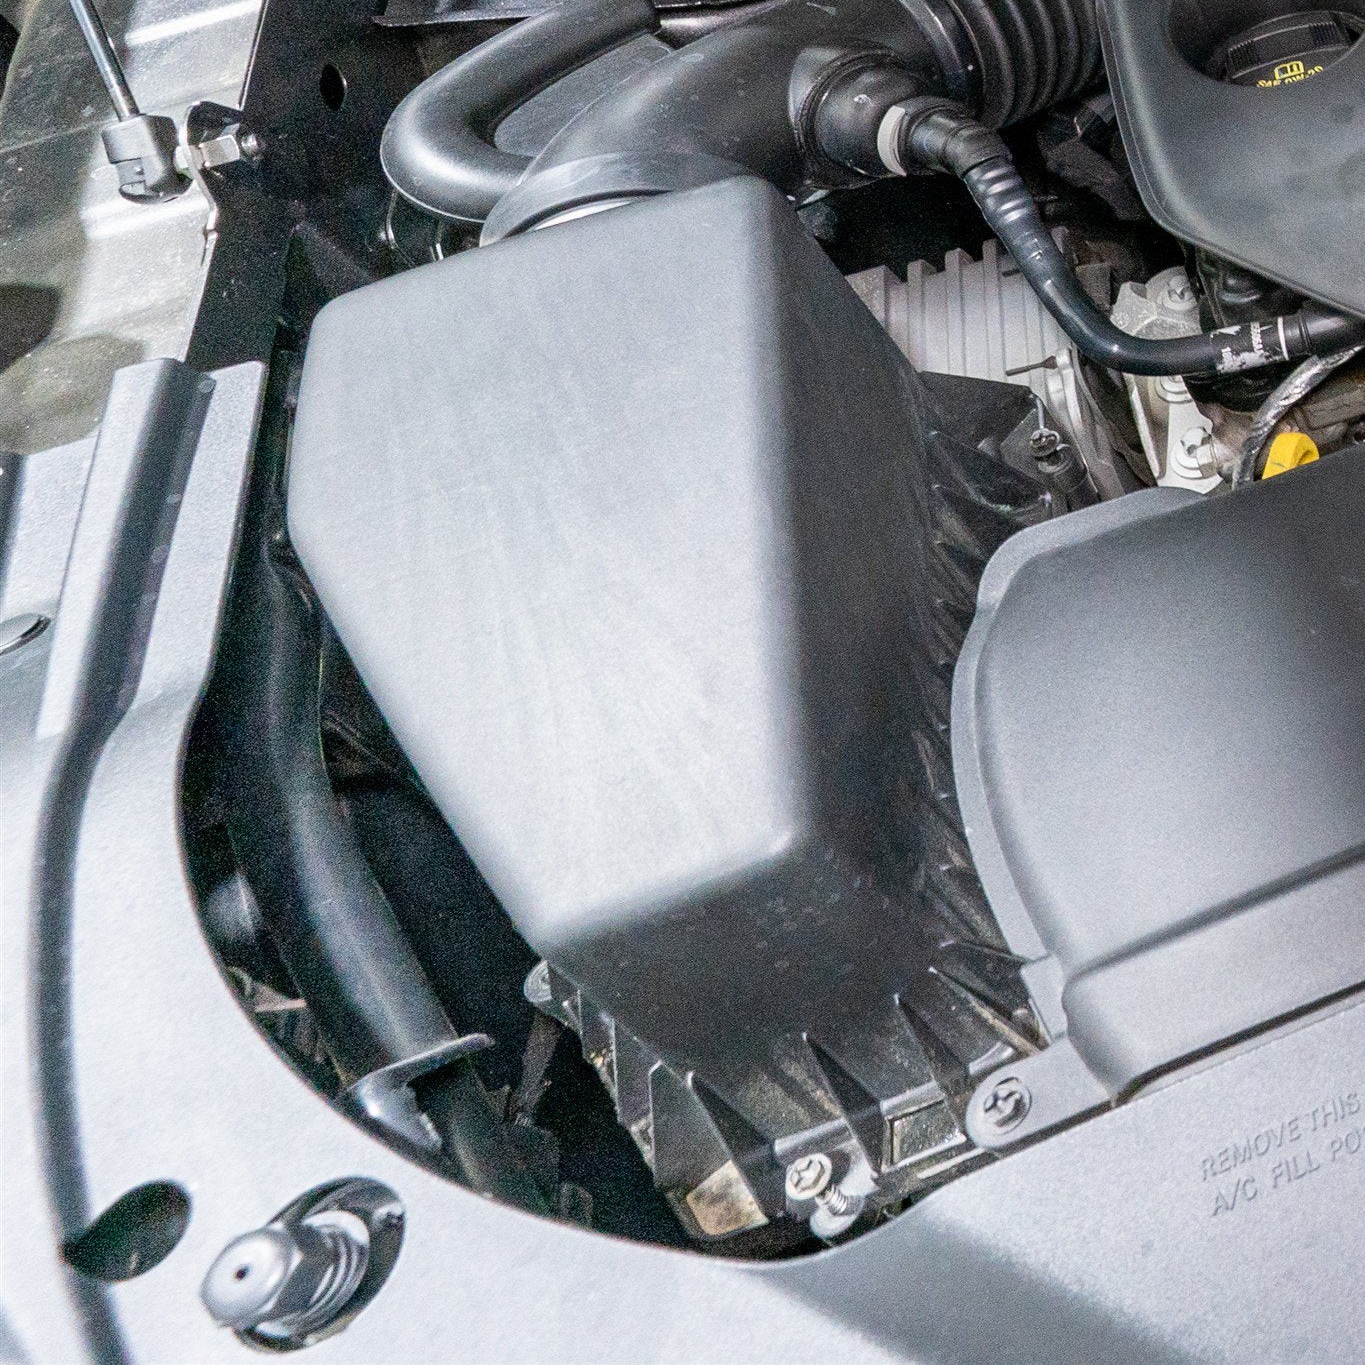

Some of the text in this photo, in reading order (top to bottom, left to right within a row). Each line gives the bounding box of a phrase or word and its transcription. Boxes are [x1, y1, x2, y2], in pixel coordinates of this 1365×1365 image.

[1200, 1117, 1302, 1182] REMOVE
[1306, 1090, 1361, 1136] THIS
[1209, 1174, 1259, 1218] A/C
[1270, 1149, 1321, 1190] FILL
